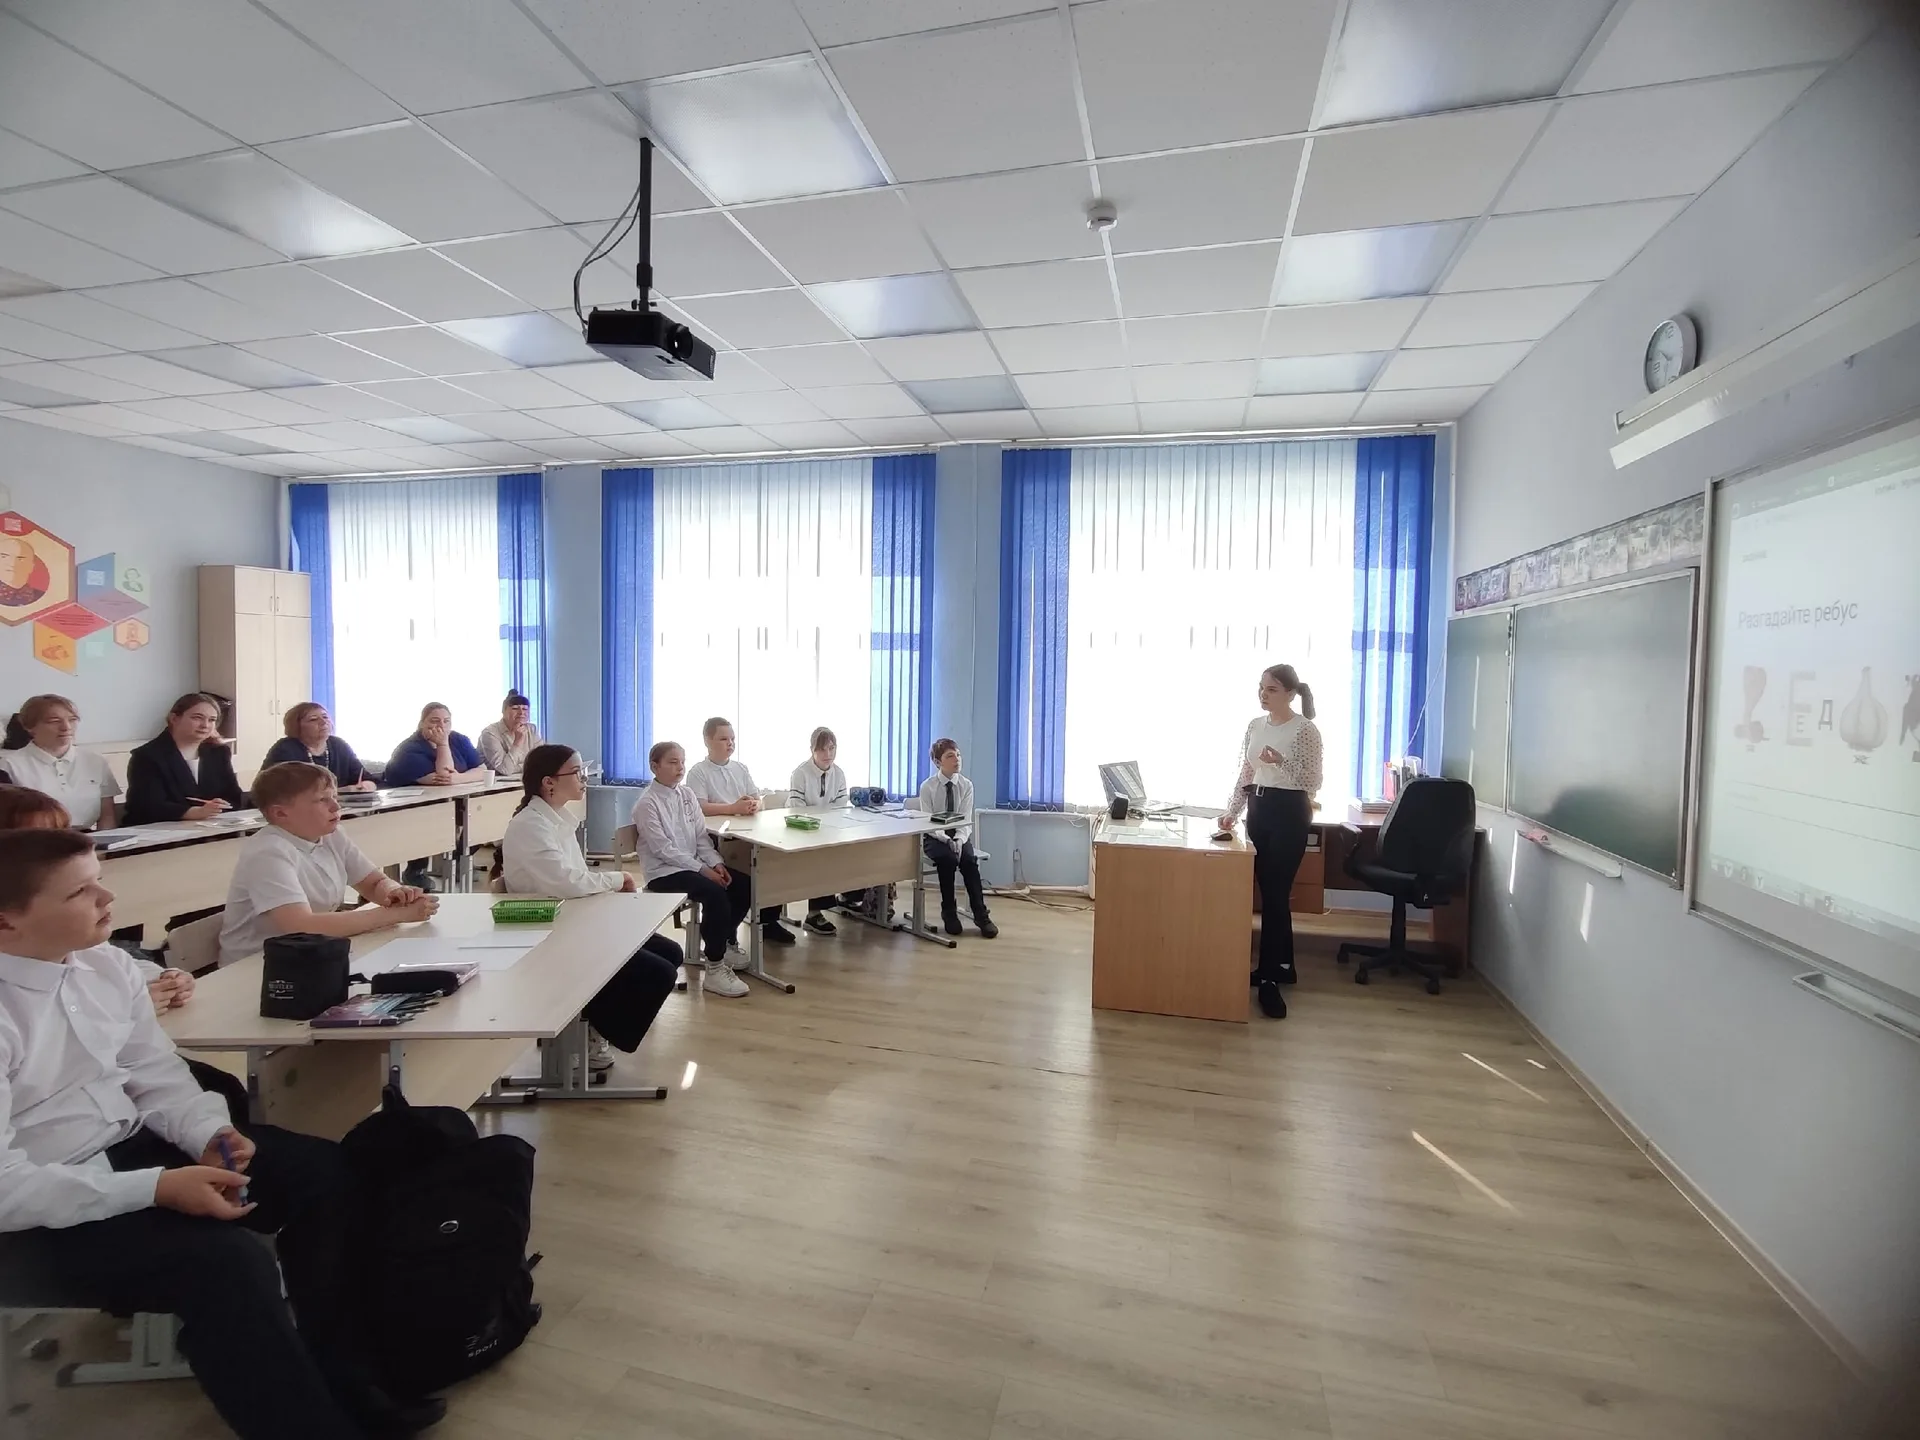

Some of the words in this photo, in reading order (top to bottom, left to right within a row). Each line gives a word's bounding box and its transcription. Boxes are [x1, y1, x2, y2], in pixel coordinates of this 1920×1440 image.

[1739, 605, 1810, 631] Разгадайте
[1814, 599, 1858, 629] ребус
[1818, 699, 1833, 731] Д
